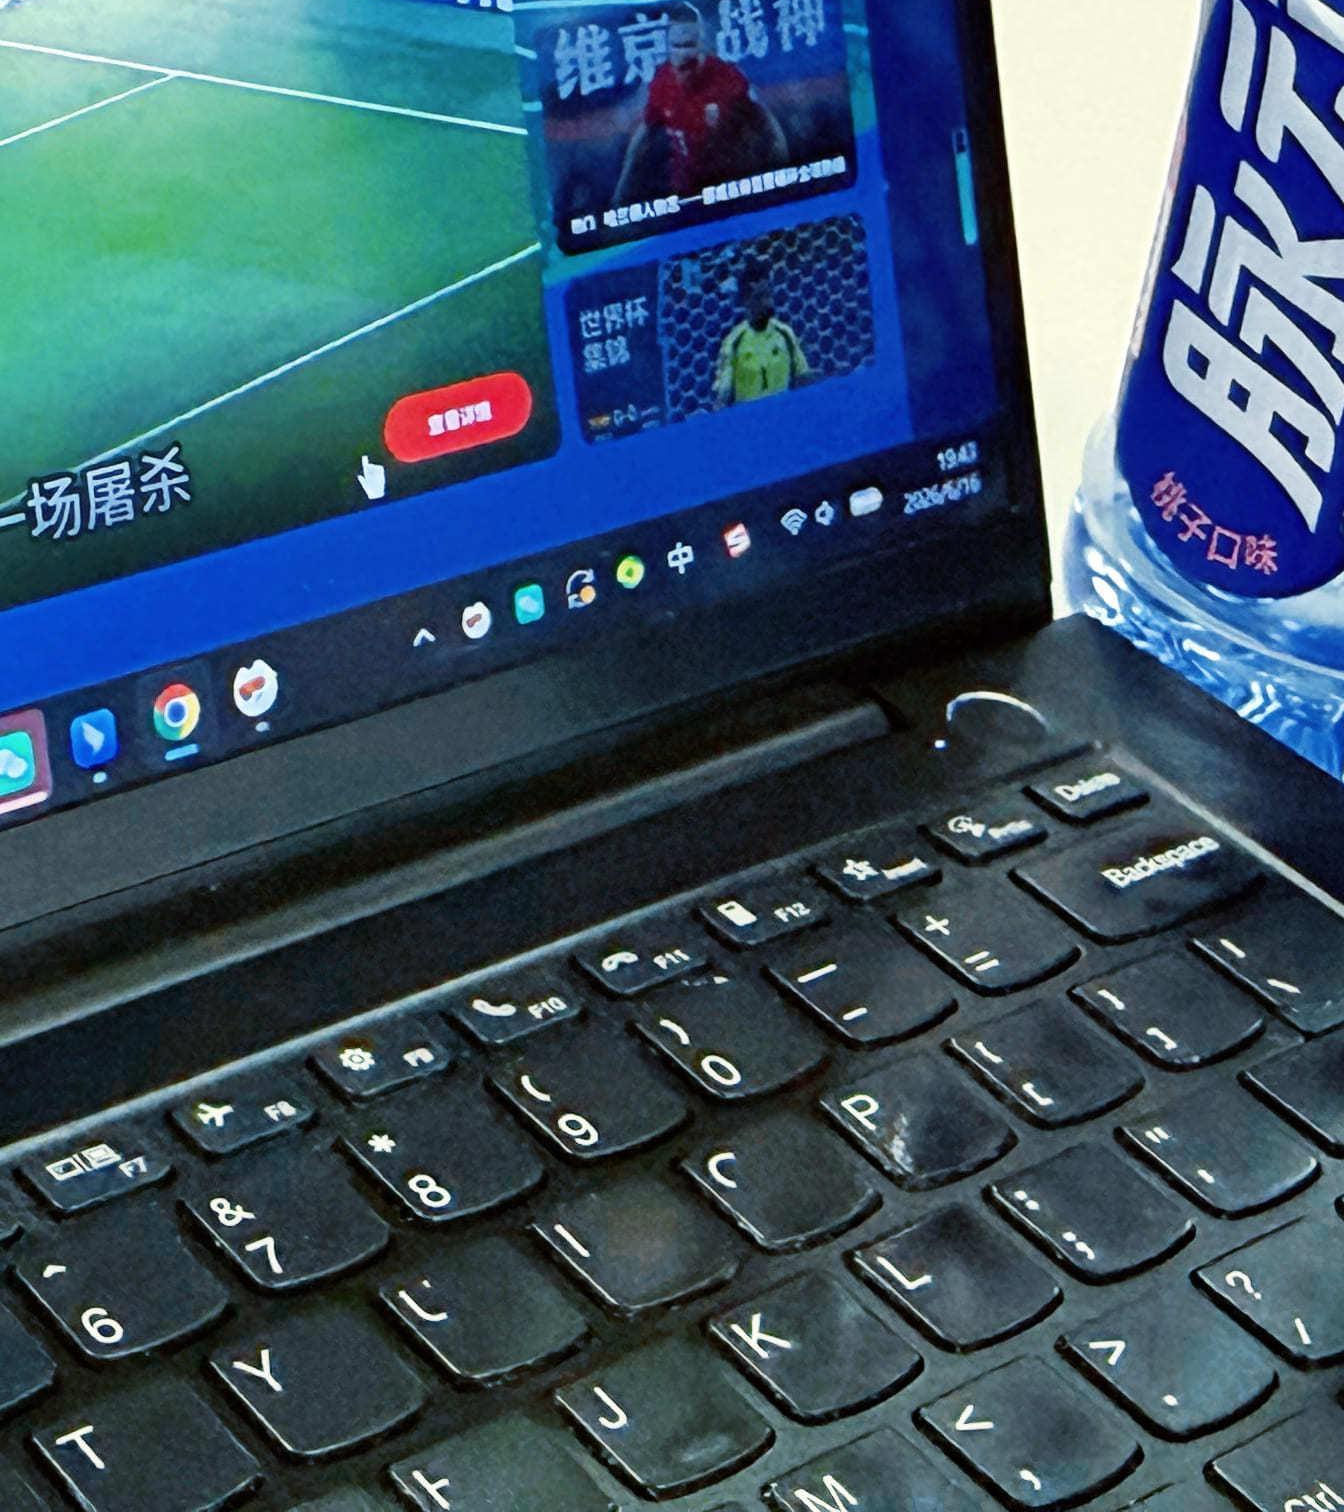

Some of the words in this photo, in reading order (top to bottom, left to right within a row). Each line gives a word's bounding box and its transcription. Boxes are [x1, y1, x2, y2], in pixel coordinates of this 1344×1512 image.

[1151, 472, 1278, 575] 桃子口味
[667, 542, 693, 573] 中
[773, 902, 811, 923] F12
[653, 949, 691, 970] F11
[527, 996, 568, 1020] F10
[700, 1054, 742, 1086] 0
[840, 1094, 880, 1130] P
[556, 1113, 600, 1147] 9
[406, 1174, 452, 1209] 8
[209, 1197, 256, 1228] &
[245, 1236, 283, 1275] 7
[876, 1255, 933, 1290] L
[80, 1307, 124, 1344] 6
[730, 1312, 793, 1359] K
[232, 1348, 283, 1392] Y
[593, 1386, 628, 1429] J
[55, 1425, 105, 1471] T
[793, 1473, 860, 1512] M
